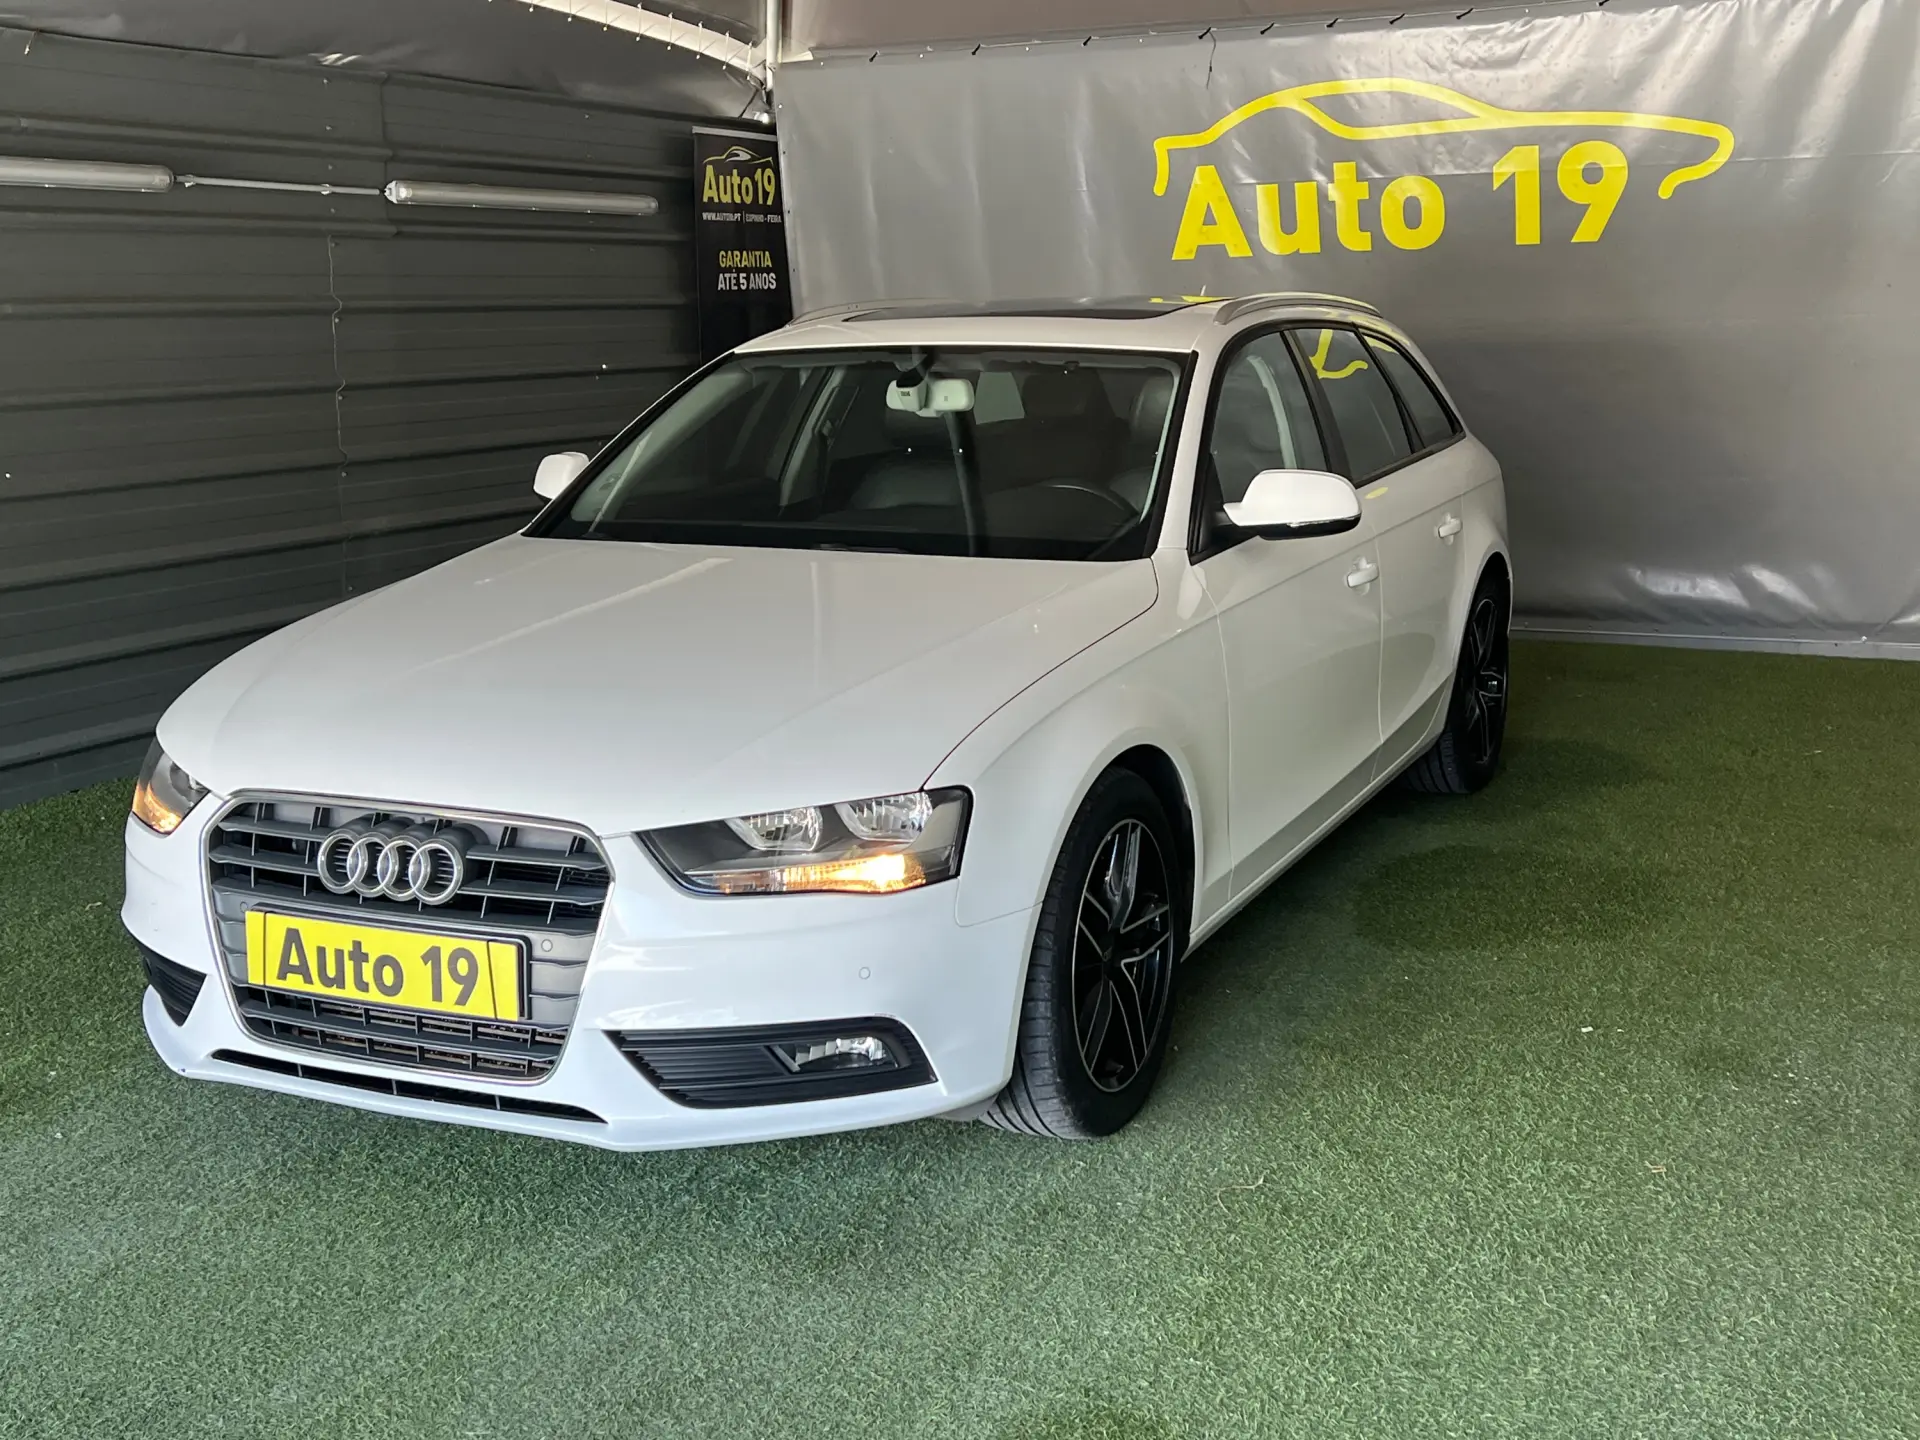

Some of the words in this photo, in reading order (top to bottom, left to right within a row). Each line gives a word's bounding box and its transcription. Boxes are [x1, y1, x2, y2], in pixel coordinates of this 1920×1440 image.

[702, 164, 753, 204] Auto
[754, 168, 776, 205] 19
[1171, 161, 1446, 260] Auto
[1492, 140, 1630, 246] 19
[717, 268, 738, 291] ATÉ
[739, 273, 747, 290] 5
[749, 272, 777, 290] ANOS
[719, 250, 772, 268] GARANTIA
[276, 927, 404, 997] Auto
[420, 945, 479, 1007] 19
